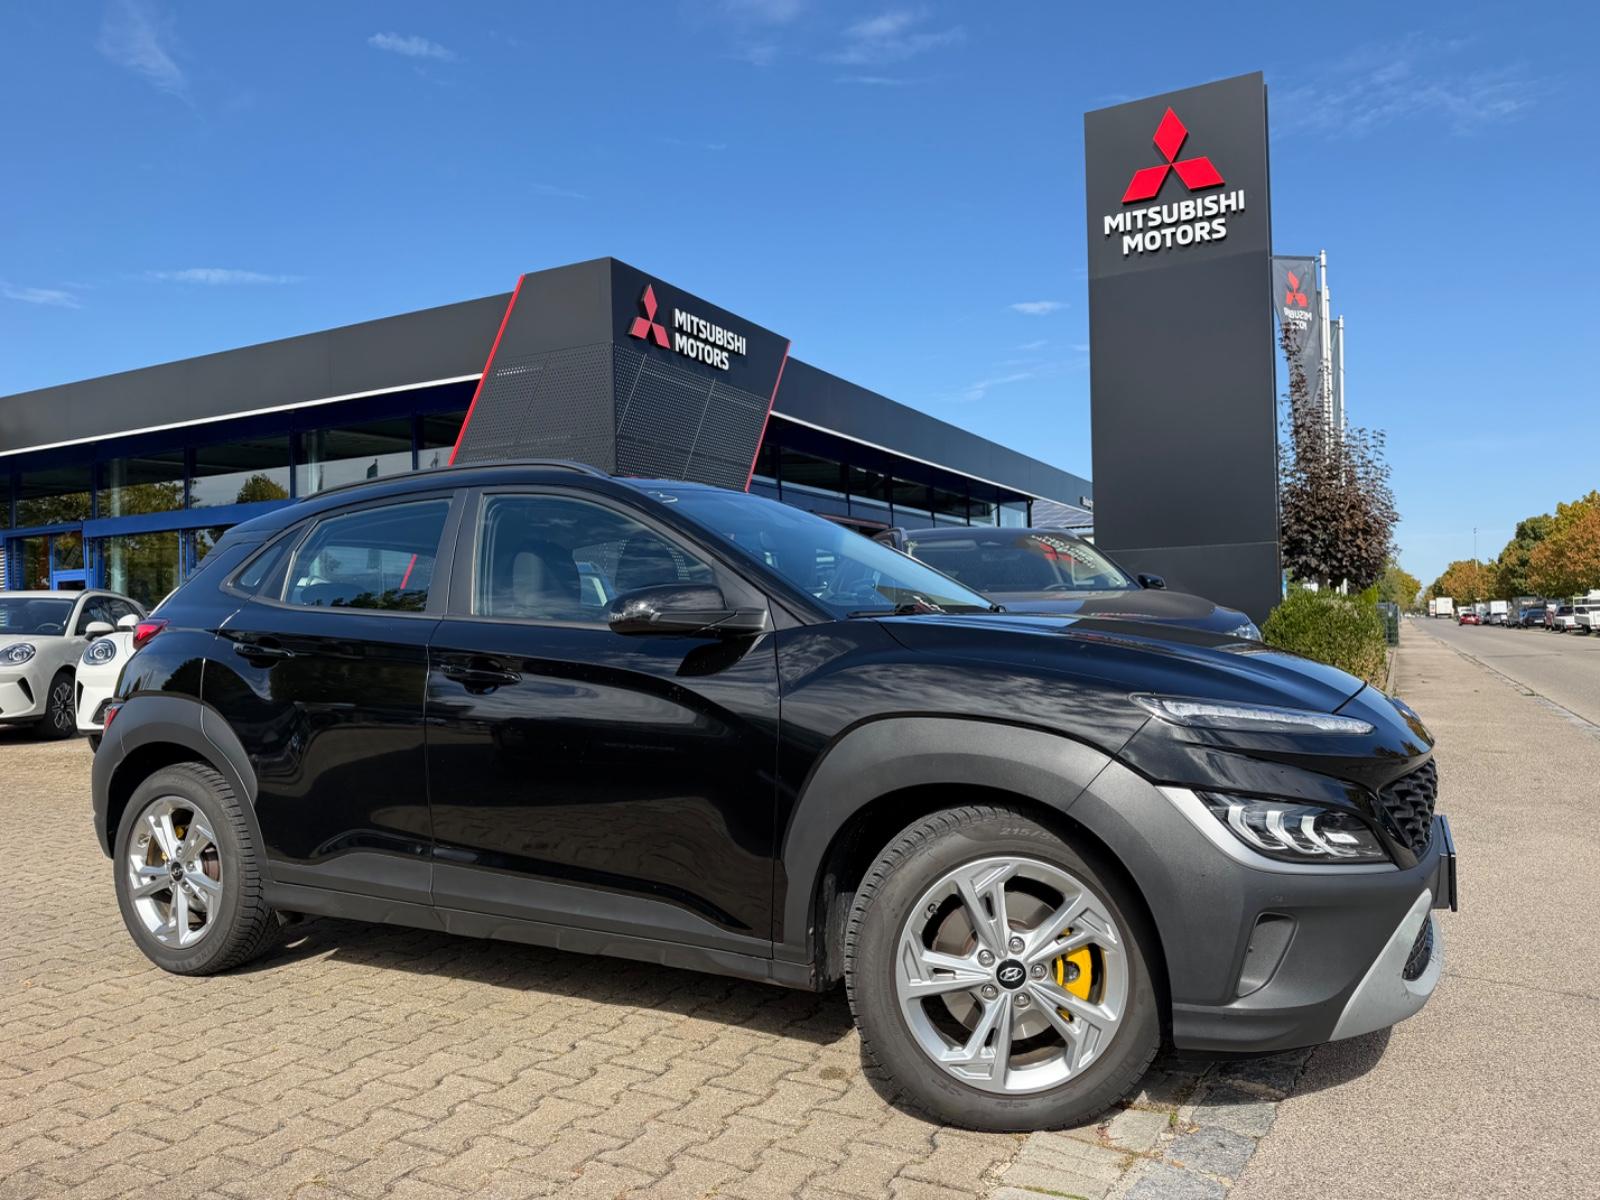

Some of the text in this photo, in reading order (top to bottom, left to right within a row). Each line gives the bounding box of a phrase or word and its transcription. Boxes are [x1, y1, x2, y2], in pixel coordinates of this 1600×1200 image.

[1103, 189, 1245, 235] MITSUBISHI
[1123, 218, 1227, 255] MOTORS
[674, 308, 746, 356] MITSUBISHI
[674, 332, 730, 371] MOTORS
